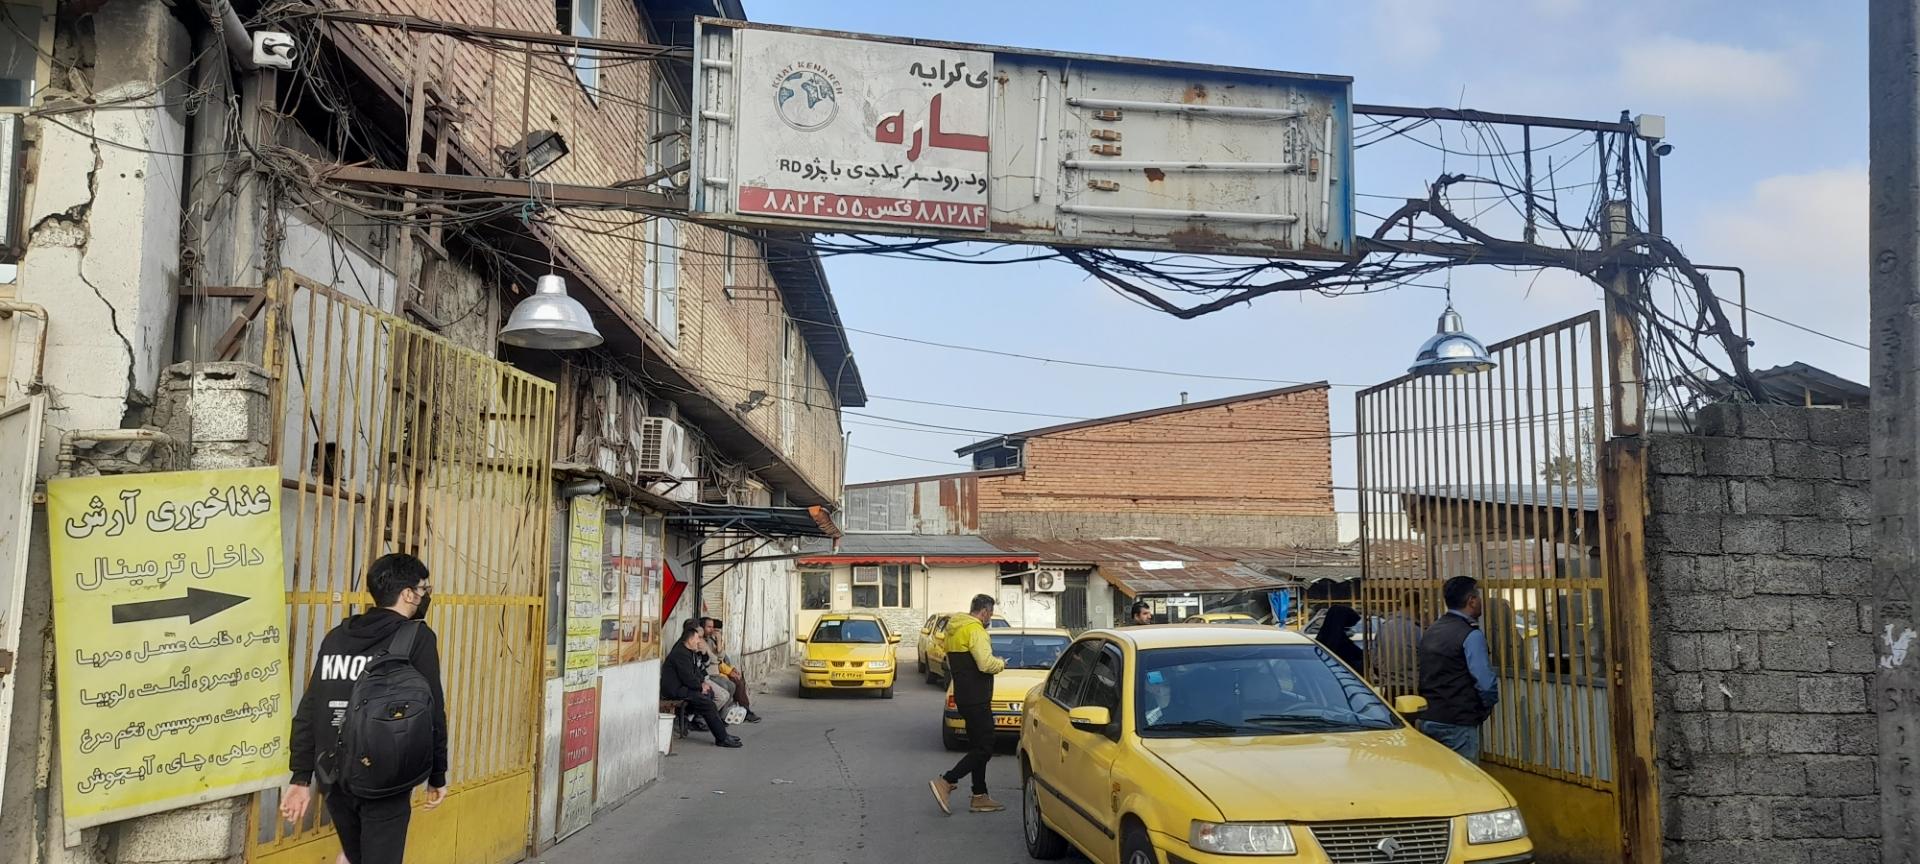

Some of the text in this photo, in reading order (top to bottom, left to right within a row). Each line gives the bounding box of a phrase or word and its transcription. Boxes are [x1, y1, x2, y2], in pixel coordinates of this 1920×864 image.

[909, 59, 966, 89] کرایه
[802, 157, 828, 183] پژو
[66, 485, 271, 539] غذاخوری آرش
[76, 543, 264, 590] داخل ترمینال
[189, 630, 234, 649] خامه
[76, 648, 122, 668] مربا
[321, 654, 373, 681] KNO
[80, 684, 126, 709] لوبیا
[115, 722, 145, 749] تخم
[147, 713, 212, 740] سوسیس
[80, 729, 112, 754] مرغ
[260, 736, 281, 758] تن
[77, 754, 155, 794] آبجوش
